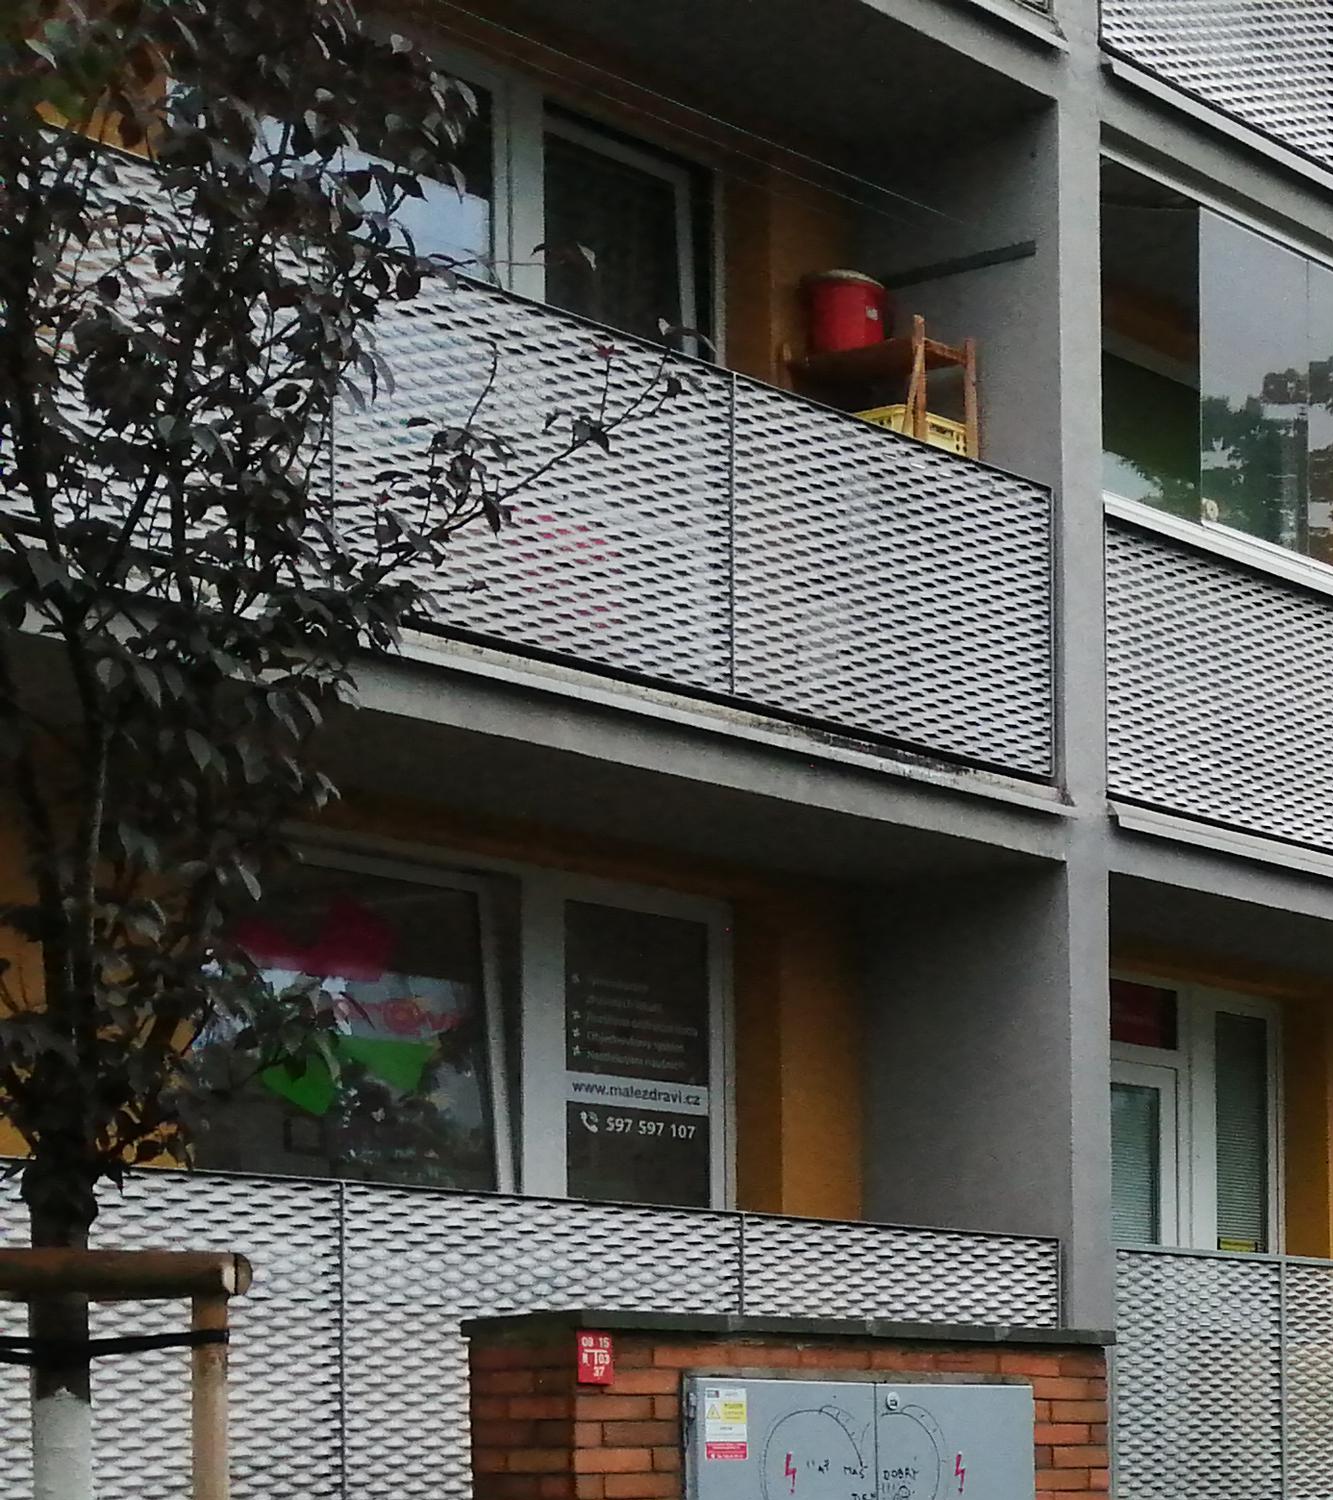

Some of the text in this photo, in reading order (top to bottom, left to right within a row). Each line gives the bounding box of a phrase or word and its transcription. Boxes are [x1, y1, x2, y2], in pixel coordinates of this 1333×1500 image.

[606, 1116, 696, 1139] 597 597 107
